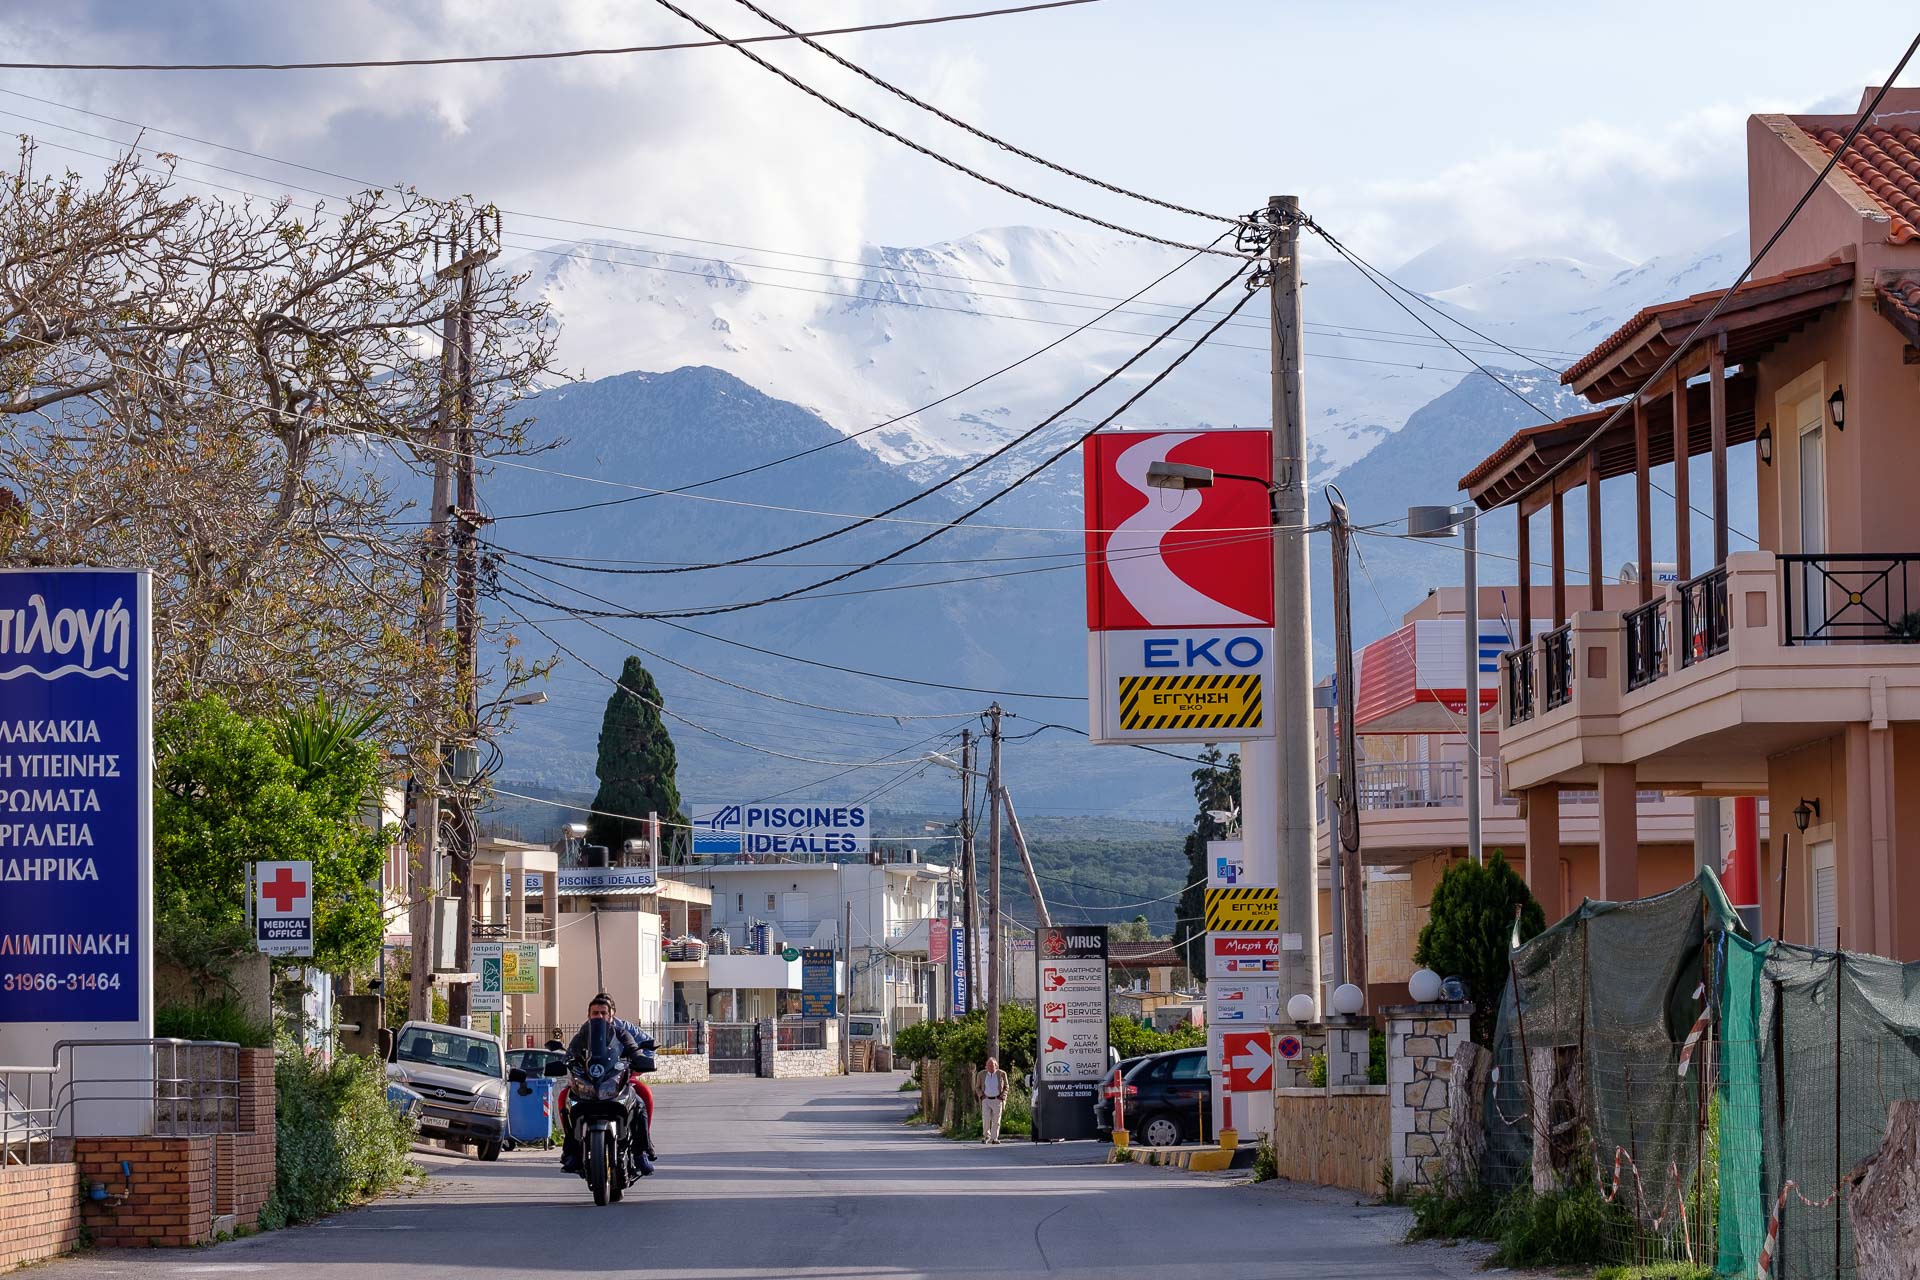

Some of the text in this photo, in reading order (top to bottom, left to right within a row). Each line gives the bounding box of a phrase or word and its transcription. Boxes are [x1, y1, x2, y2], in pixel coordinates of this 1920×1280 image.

[1153, 693, 1229, 705] ΕΓΓΥΗΣΗ
[18, 754, 120, 777] ΥΓΙΕΙΝΗΣ
[747, 807, 865, 828] PISCINES
[0, 823, 94, 847] ΡΓΑΛΕΙΑ
[747, 833, 857, 853] IDEALES
[558, 875, 651, 886] PISCINES IDEALES
[1232, 903, 1279, 911] ΕΓΓΥΗΣ
[263, 920, 308, 929] MEDICAL
[268, 929, 303, 938] OFFICE
[0, 934, 129, 955] ΛΙΜΠΙΝΑΚΗ
[1066, 935, 1102, 949] VIRUS
[3, 973, 121, 991] 31966-31464
[1067, 1008, 1102, 1016] SERVICE
[1046, 1065, 1070, 1073] KNX
[1047, 1082, 1099, 1090] www.e-virus.g
